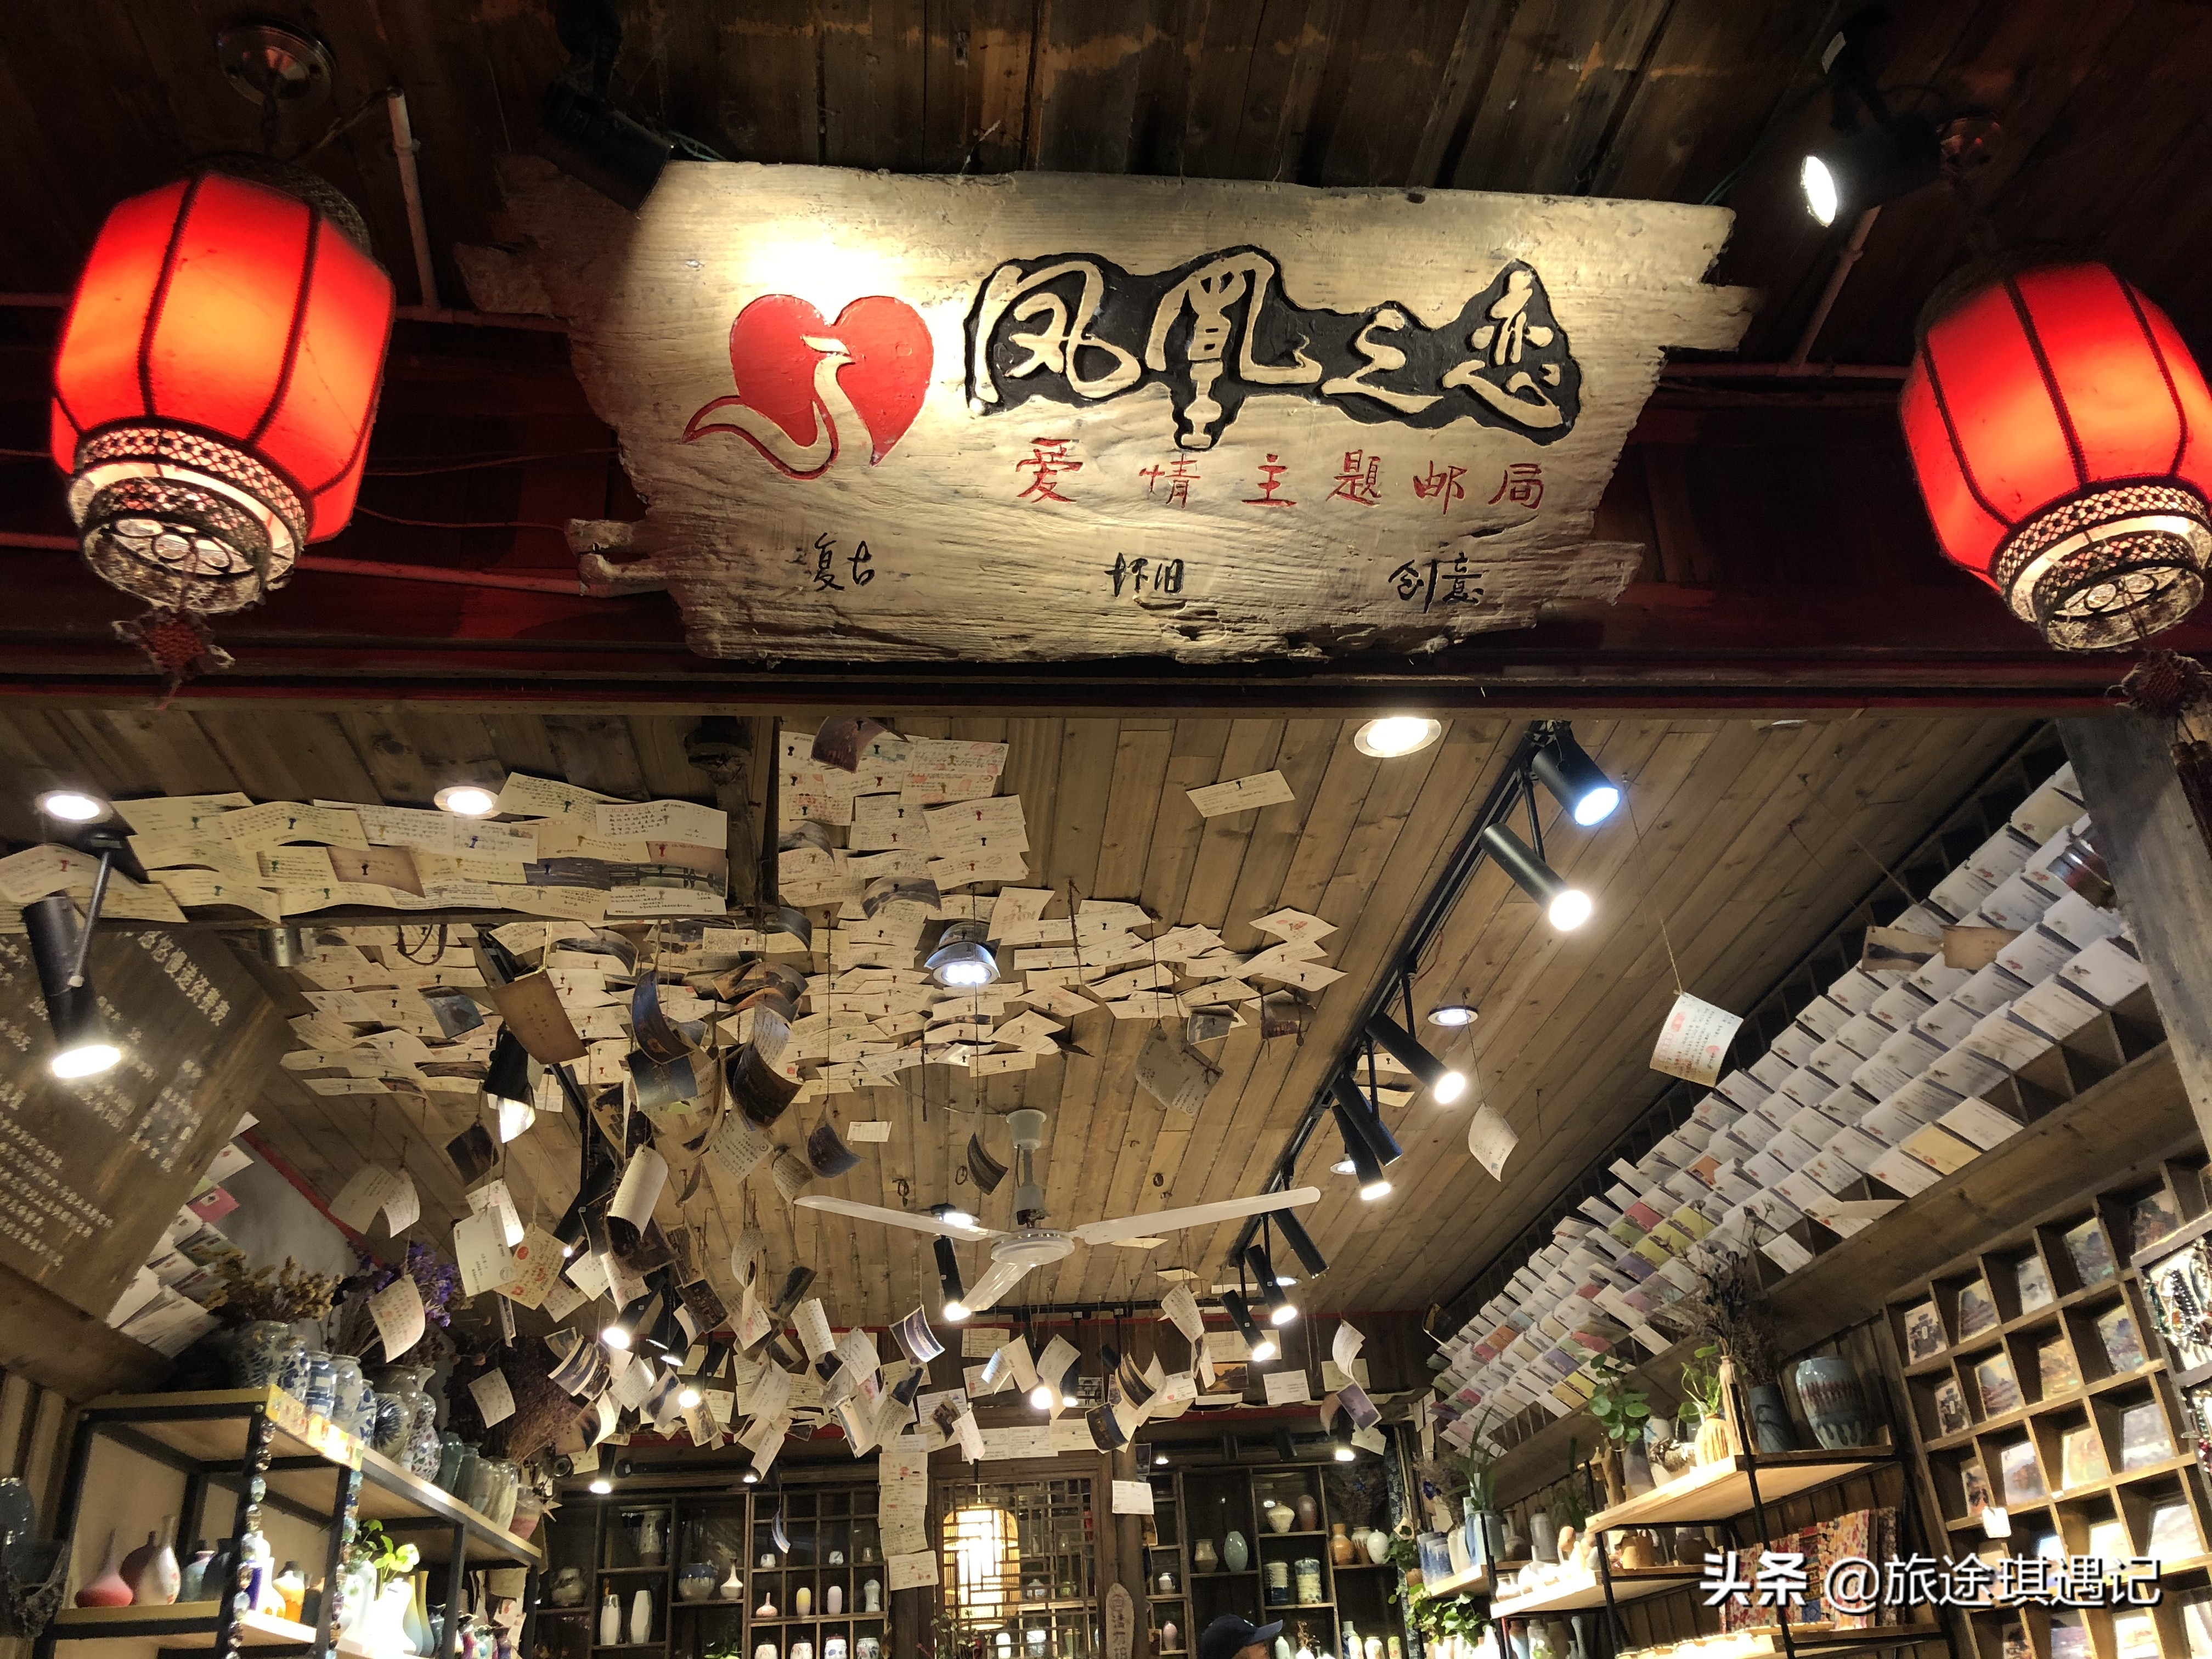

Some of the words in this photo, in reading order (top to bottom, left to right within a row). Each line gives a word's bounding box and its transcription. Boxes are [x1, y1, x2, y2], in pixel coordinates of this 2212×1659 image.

[968, 246, 1579, 449] 凤凰之恋
[1015, 437, 1545, 514] 爱情主题邮局
[1104, 552, 1184, 597] 怀旧
[1387, 551, 1485, 614] 创意
